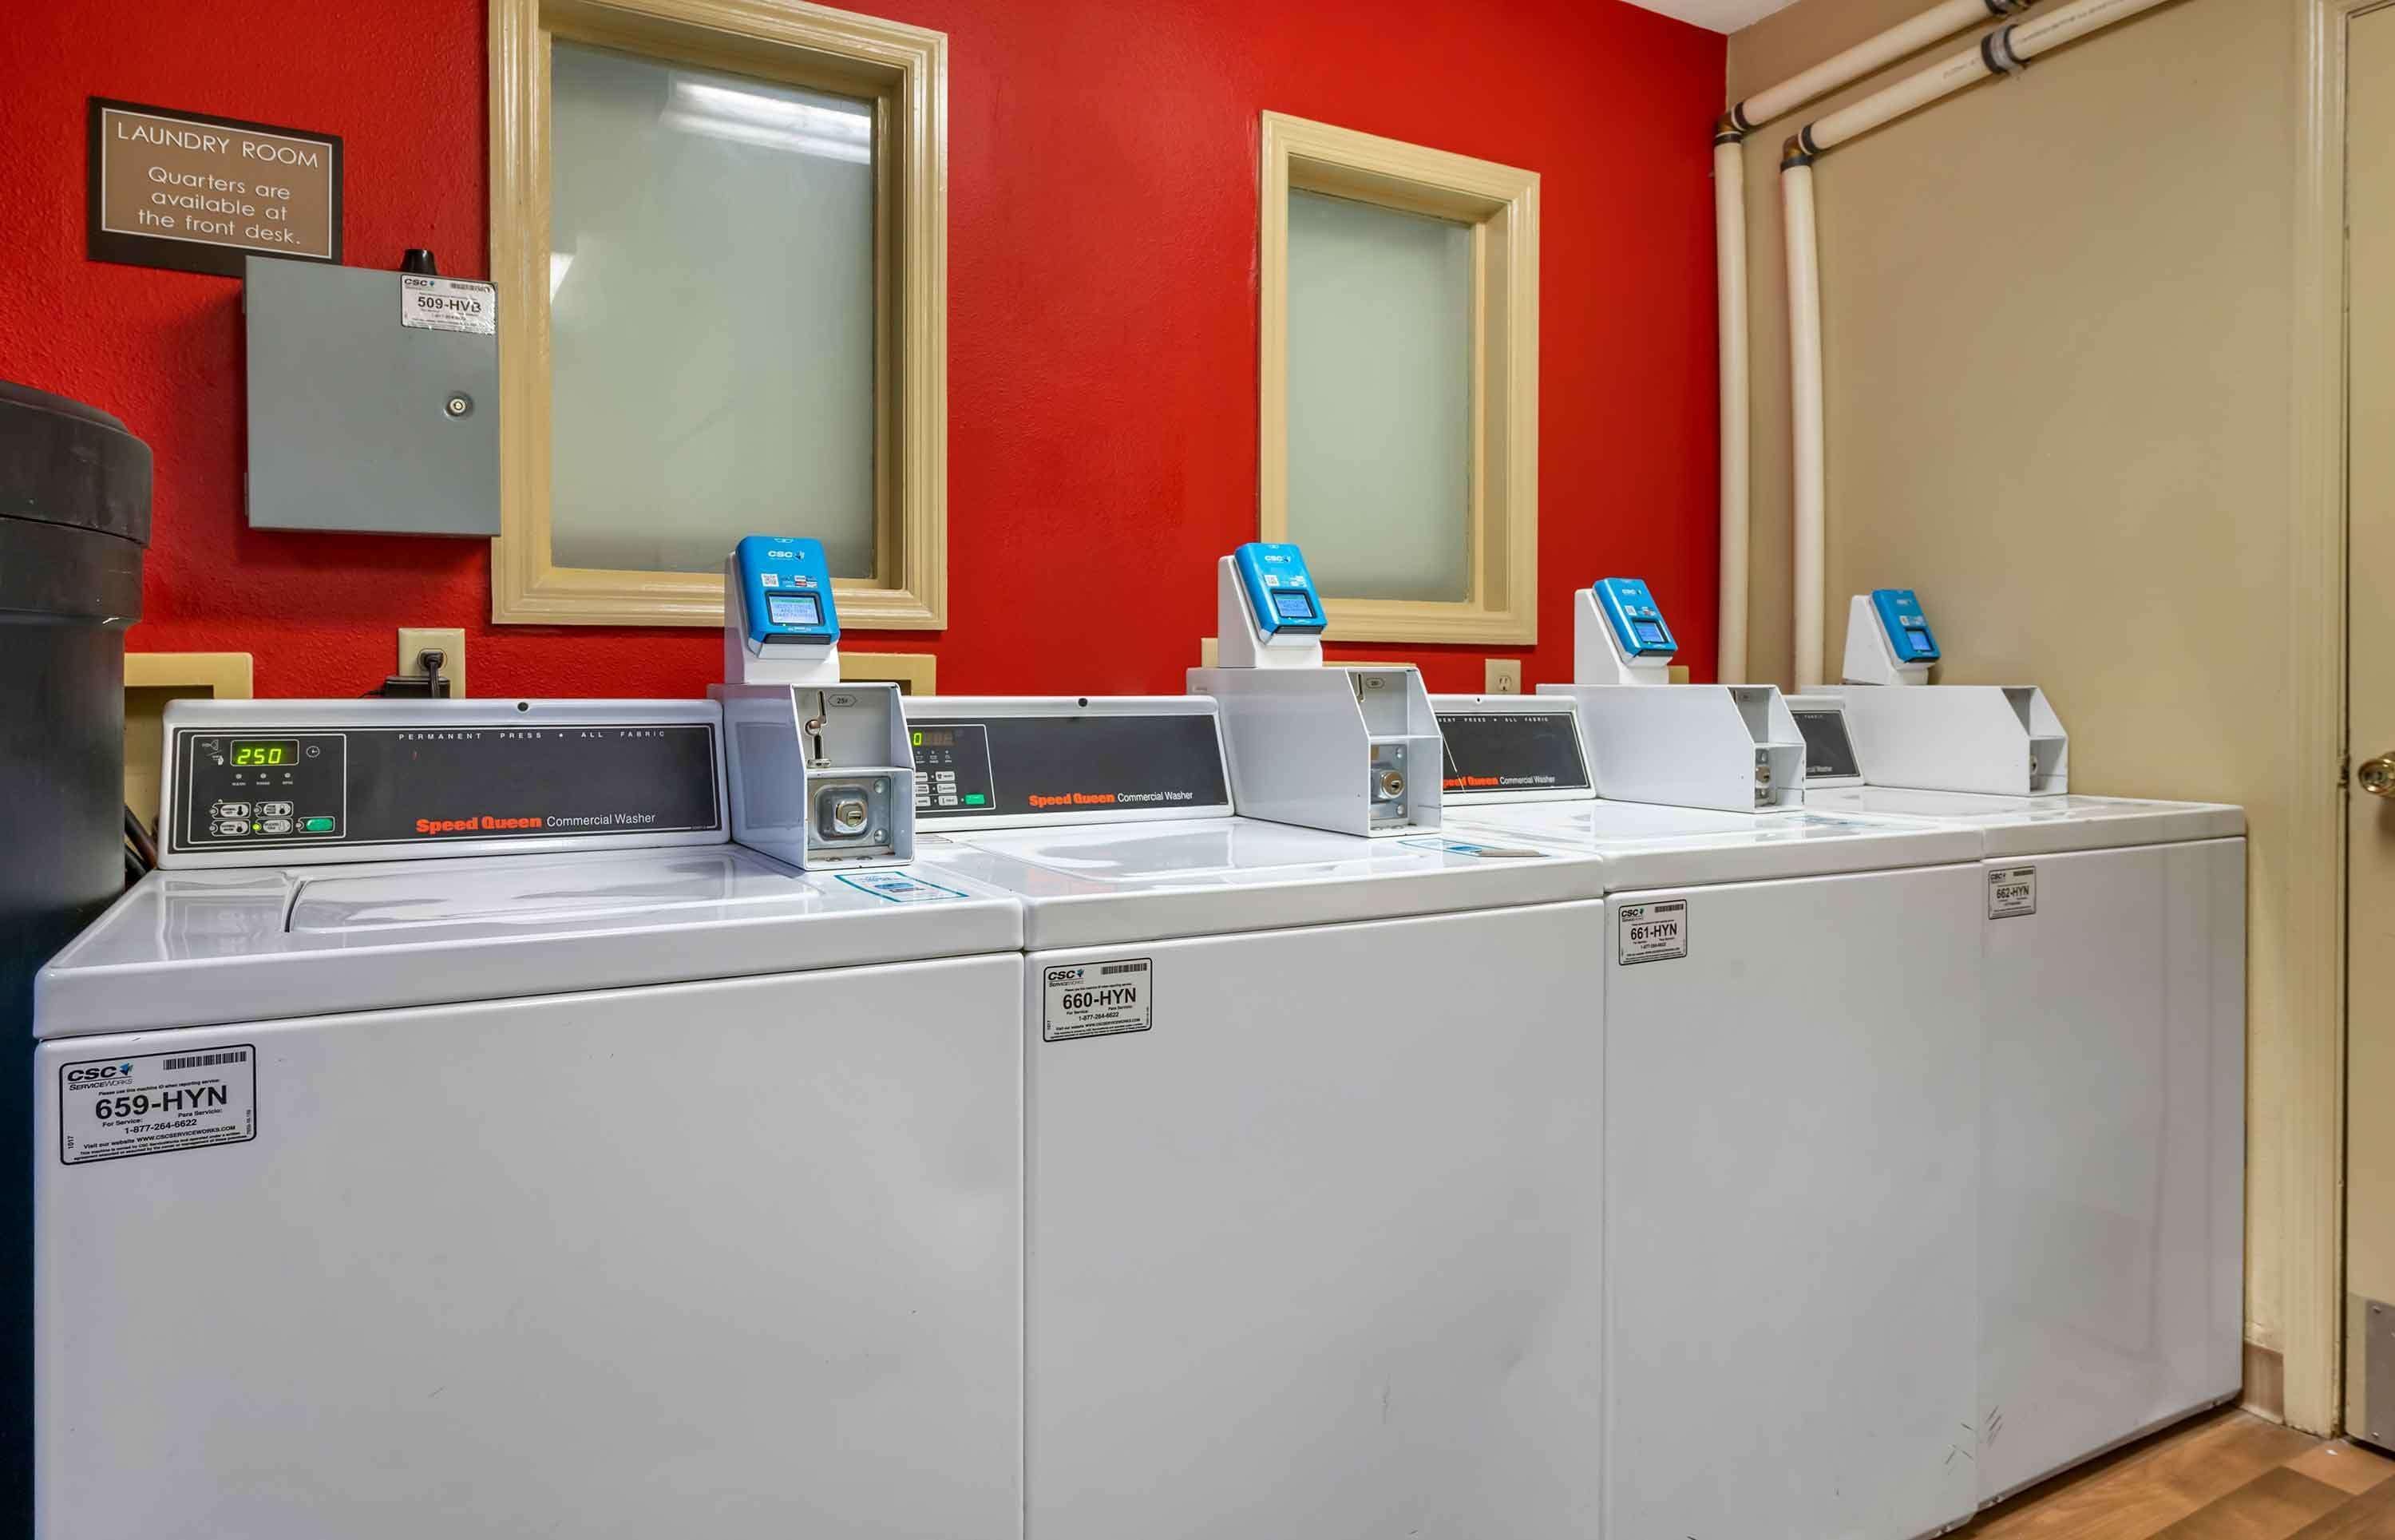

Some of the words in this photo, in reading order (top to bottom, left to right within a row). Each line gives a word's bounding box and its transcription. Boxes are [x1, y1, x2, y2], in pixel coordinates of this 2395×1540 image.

[117, 121, 231, 154] LAUNDRY
[242, 141, 319, 168] ROOM
[148, 166, 245, 195] Quarters
[255, 184, 291, 200] are
[152, 192, 255, 217] available
[265, 206, 287, 221] at
[138, 208, 175, 228] the
[185, 216, 236, 236] front
[244, 224, 302, 245] desk.
[404, 278, 429, 287] CSC
[236, 748, 283, 766] 250
[1029, 794, 1072, 808] Speed
[1073, 792, 1116, 805] Queen
[1118, 791, 1164, 803] Commercial
[1164, 790, 1194, 801] Washer
[416, 817, 479, 835] Speed
[481, 816, 542, 829] Queen
[547, 814, 612, 827] Commercial
[614, 813, 656, 825] Washer
[1621, 909, 1639, 917] CSC
[1630, 923, 1677, 940] 661-HYN
[1048, 970, 1075, 981] CSC
[1063, 988, 1136, 1010] 660-HYN
[67, 1066, 117, 1082] CSC
[95, 1085, 228, 1119] 659-HYN
[194, 1107, 222, 1116] Servicio:
[115, 1117, 143, 1126] Service:
[125, 1118, 197, 1134] 1-877-264-6622
